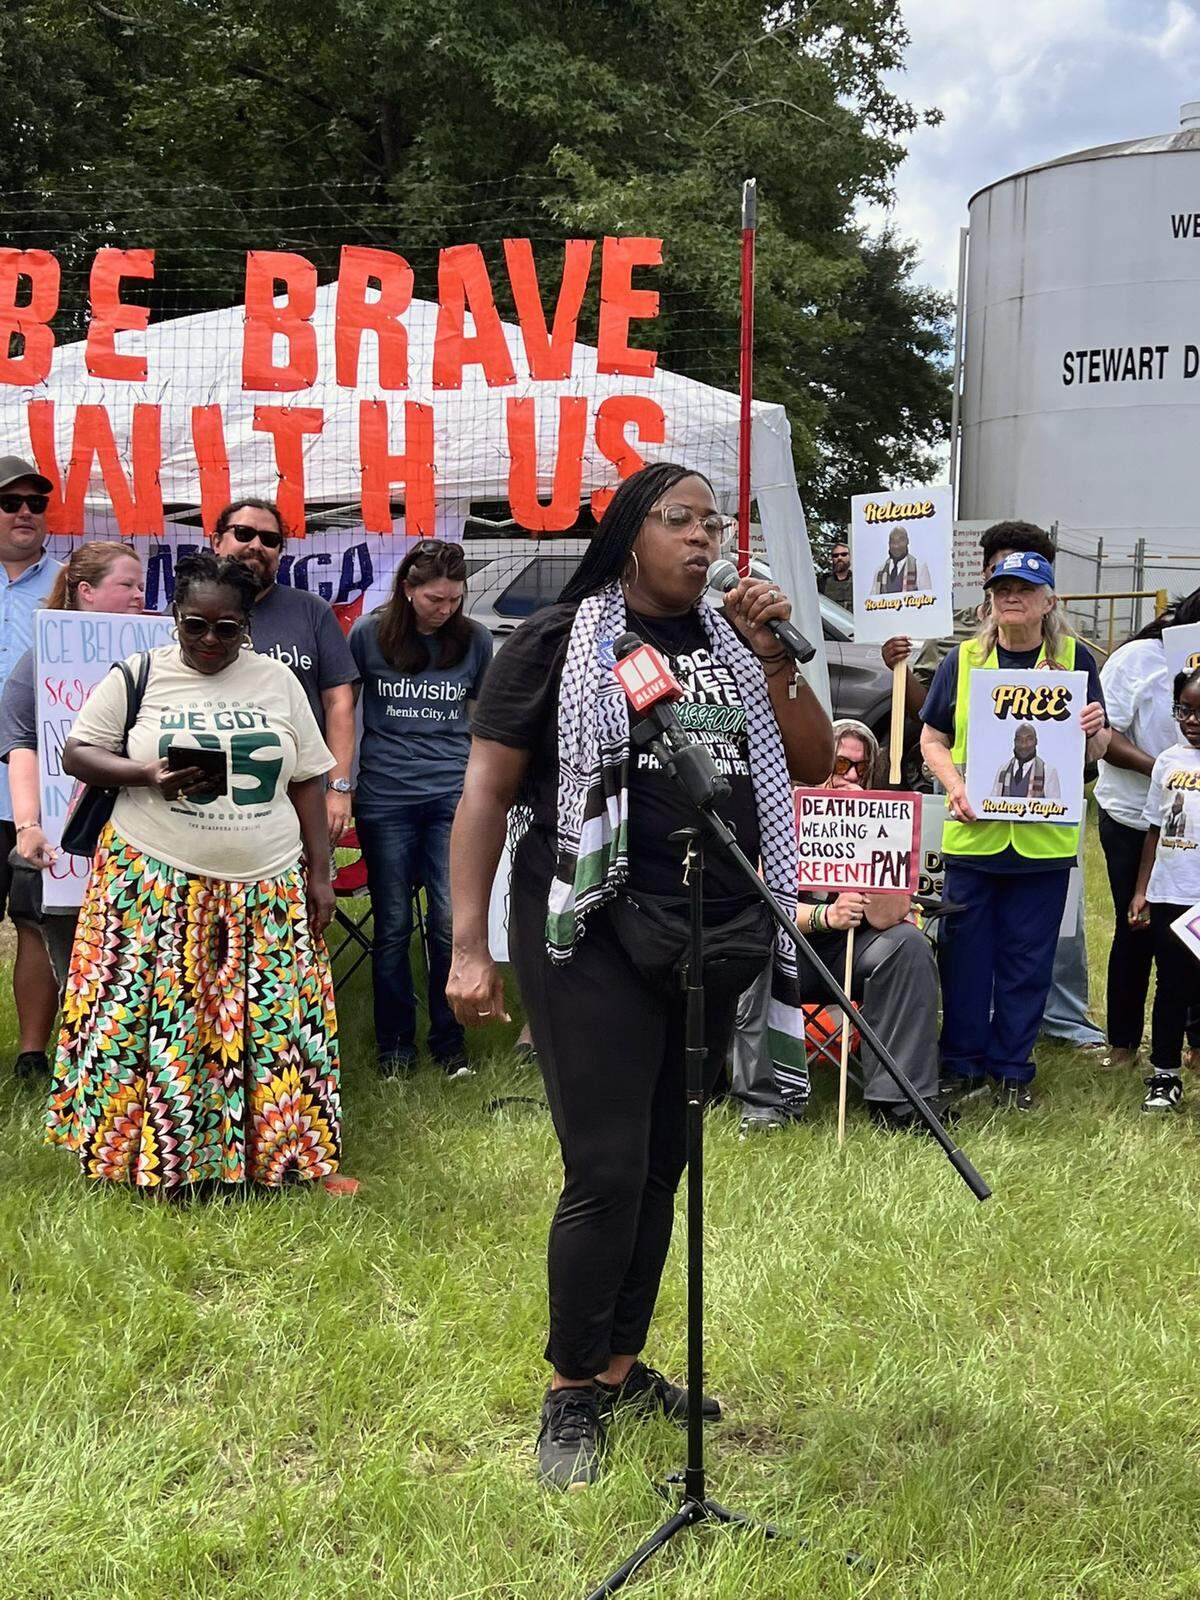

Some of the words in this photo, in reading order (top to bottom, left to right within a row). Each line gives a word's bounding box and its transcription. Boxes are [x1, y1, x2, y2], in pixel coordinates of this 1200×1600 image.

[0, 246, 155, 386] BE
[242, 236, 663, 392] BRAVE
[1063, 345, 1169, 385] STEWART
[1184, 345, 1200, 378] D
[27, 399, 436, 539] WITH
[506, 395, 665, 532] US
[864, 501, 936, 524] Release
[864, 598, 903, 612] Rodney
[904, 594, 937, 609] Taylor
[40, 619, 74, 663] ICE
[378, 678, 466, 701] Indivisible
[635, 679, 668, 705] ALIVE
[386, 704, 419, 718] Phenix
[421, 707, 446, 721] City,
[992, 684, 1072, 721] FREE
[160, 711, 206, 731] WE
[214, 710, 270, 731] GOT
[686, 731, 746, 748] OLIDARITY
[717, 743, 741, 759] THE
[802, 797, 856, 817] DEATH
[859, 800, 911, 820] DEALER
[982, 799, 1027, 817] Rodney
[1028, 800, 1068, 818] Taylor
[876, 825, 889, 839] A
[799, 841, 855, 859] CROSS
[798, 860, 871, 884] REPENT
[870, 850, 911, 888] PAM
